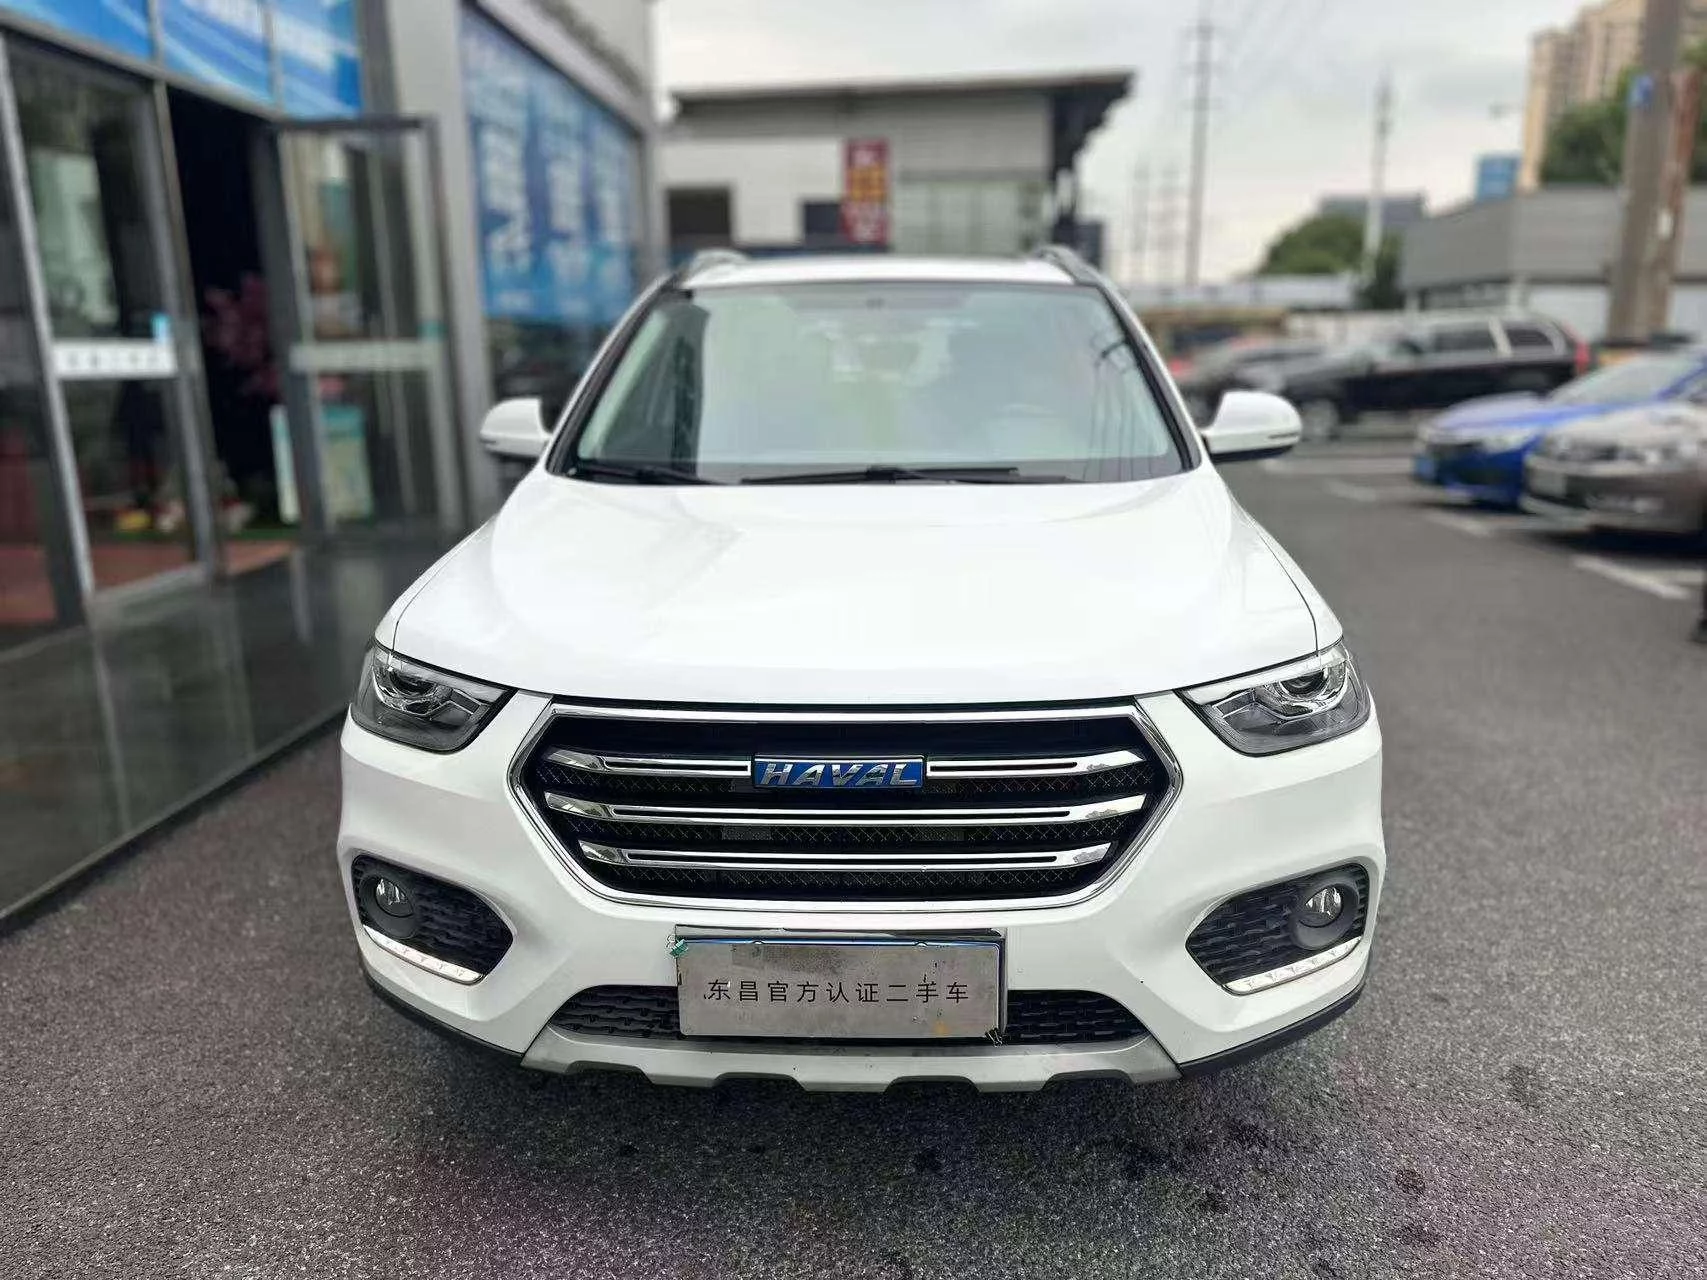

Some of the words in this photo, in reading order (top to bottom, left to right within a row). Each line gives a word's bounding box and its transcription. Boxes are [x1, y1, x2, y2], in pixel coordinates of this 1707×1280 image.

[760, 763, 917, 786] HAVAL
[707, 979, 969, 1003] 东昌官方认证二手车
